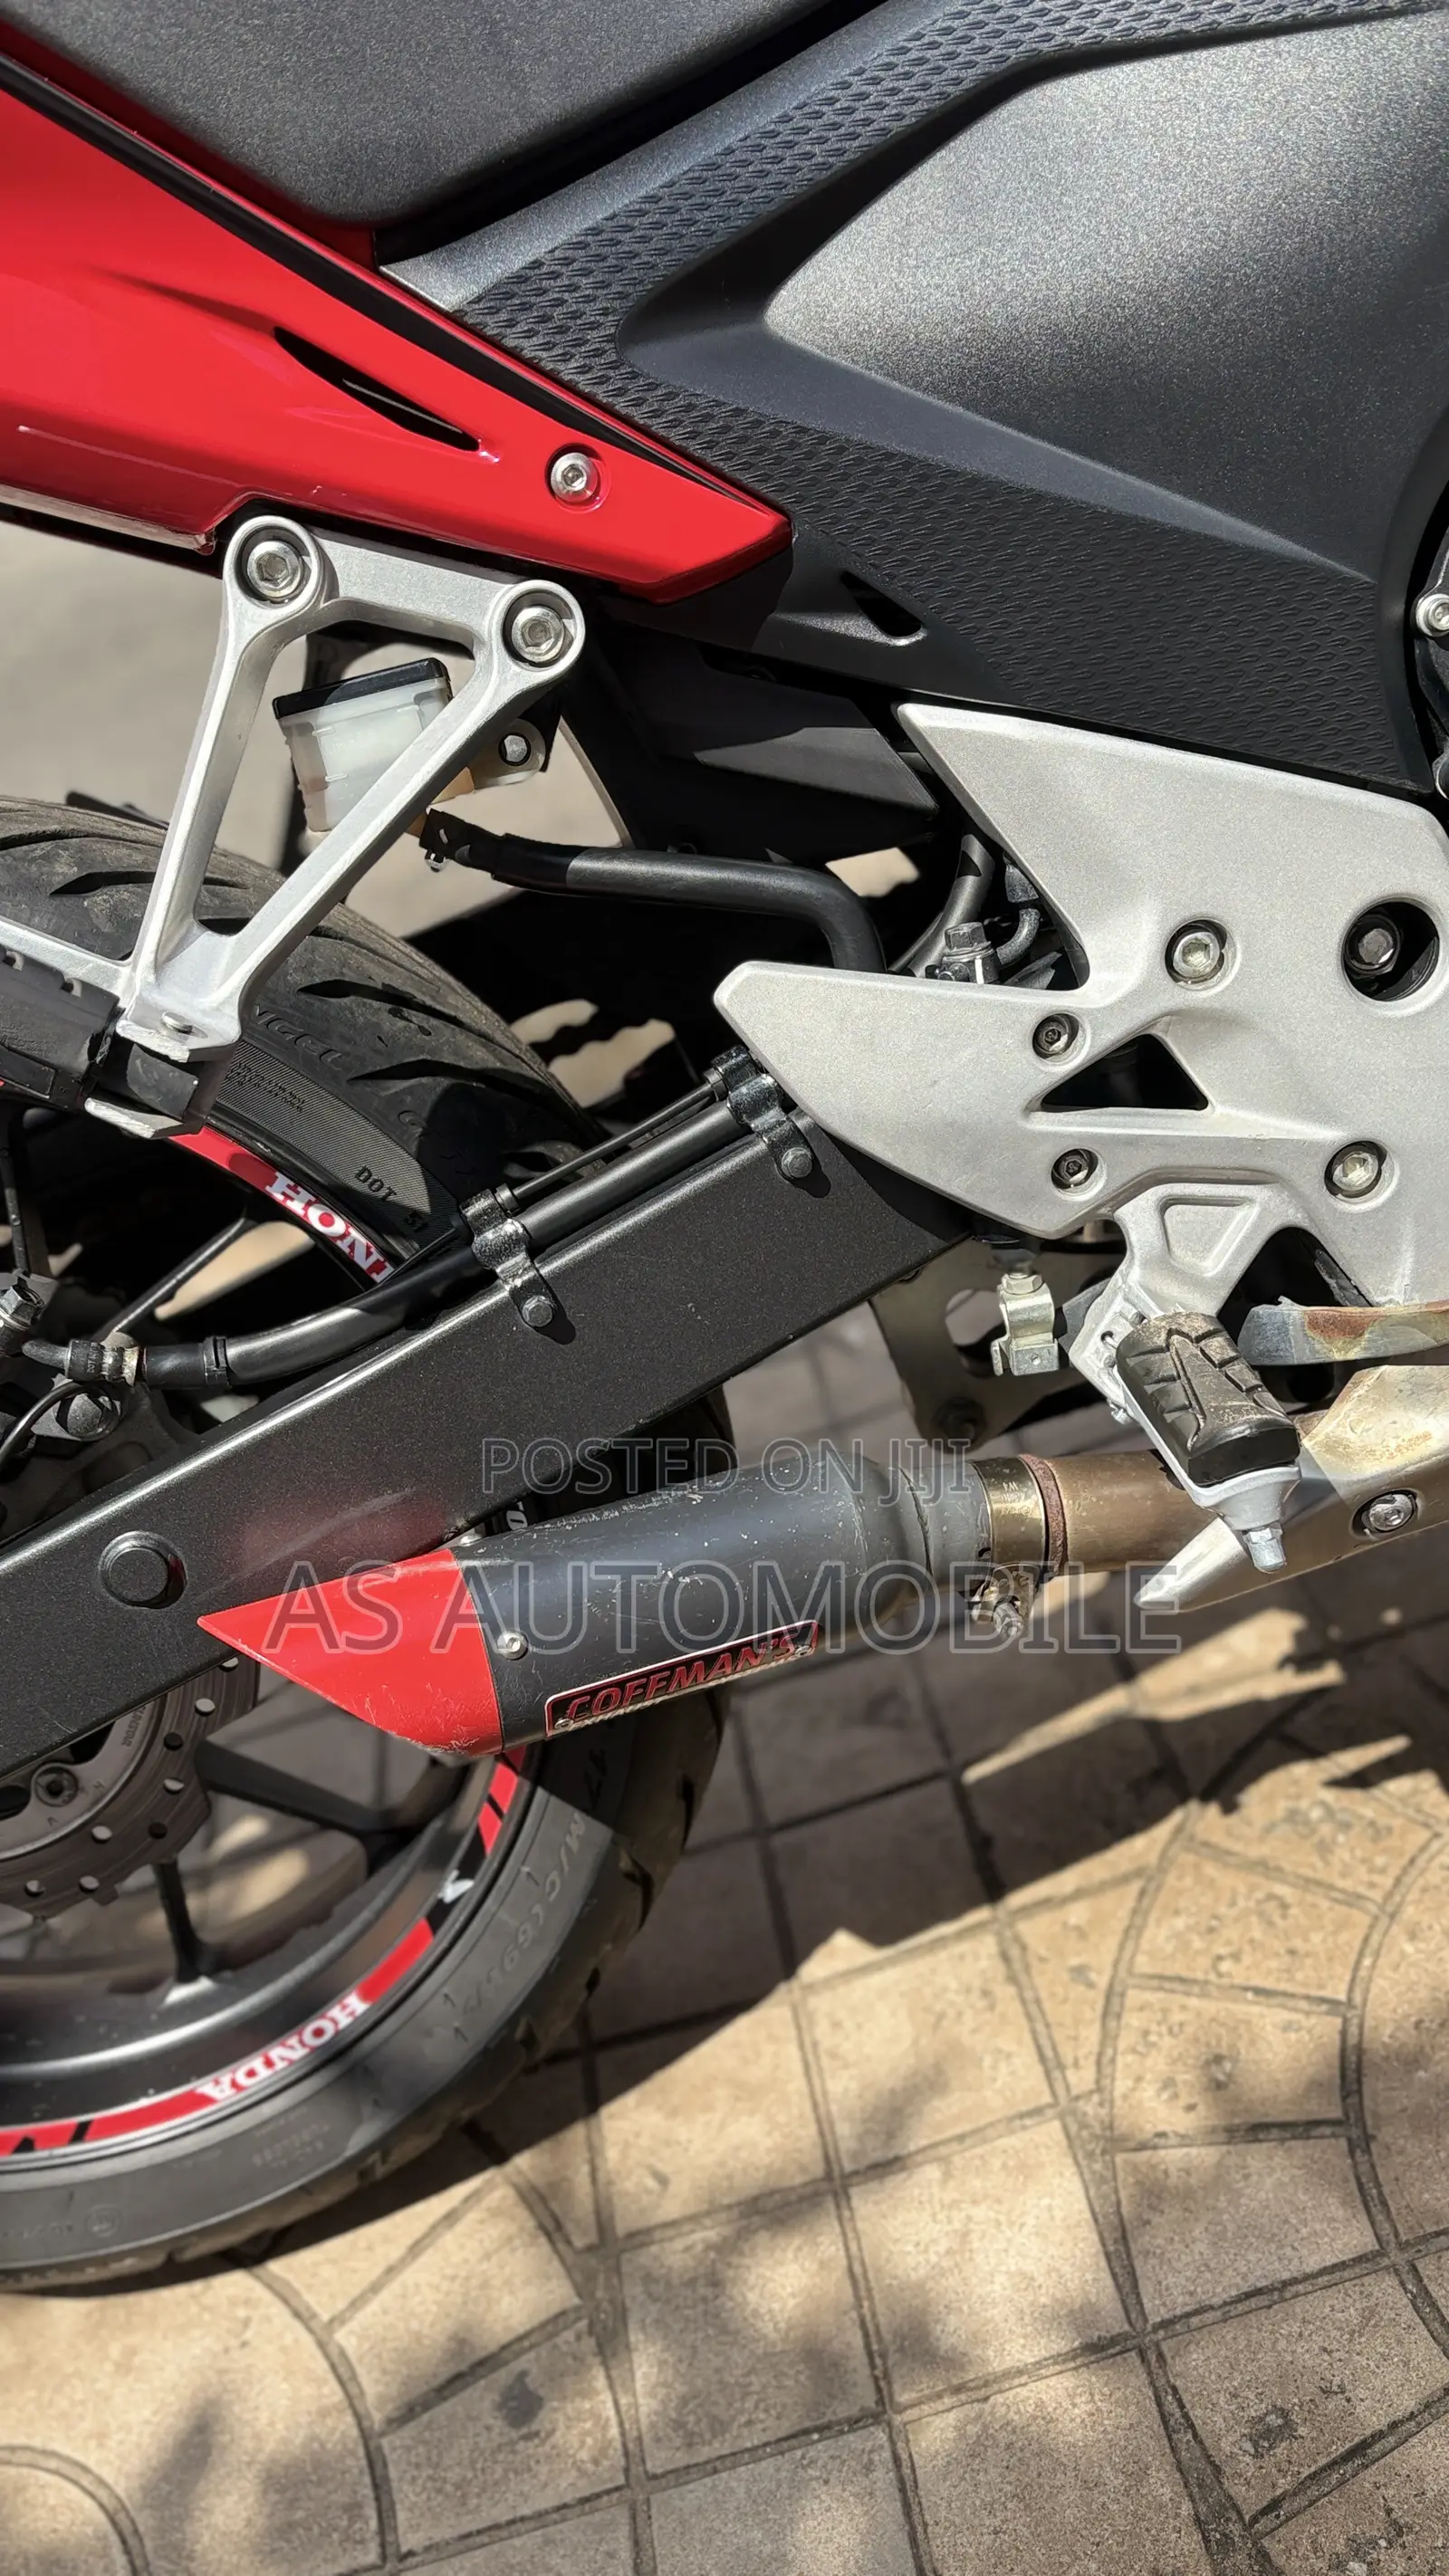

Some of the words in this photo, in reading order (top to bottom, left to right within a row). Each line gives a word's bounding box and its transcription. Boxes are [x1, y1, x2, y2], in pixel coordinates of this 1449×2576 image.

[354, 1165, 398, 1202] DOT
[566, 1633, 798, 1720] COFFMAN'S
[194, 1990, 374, 2101] HONDA
